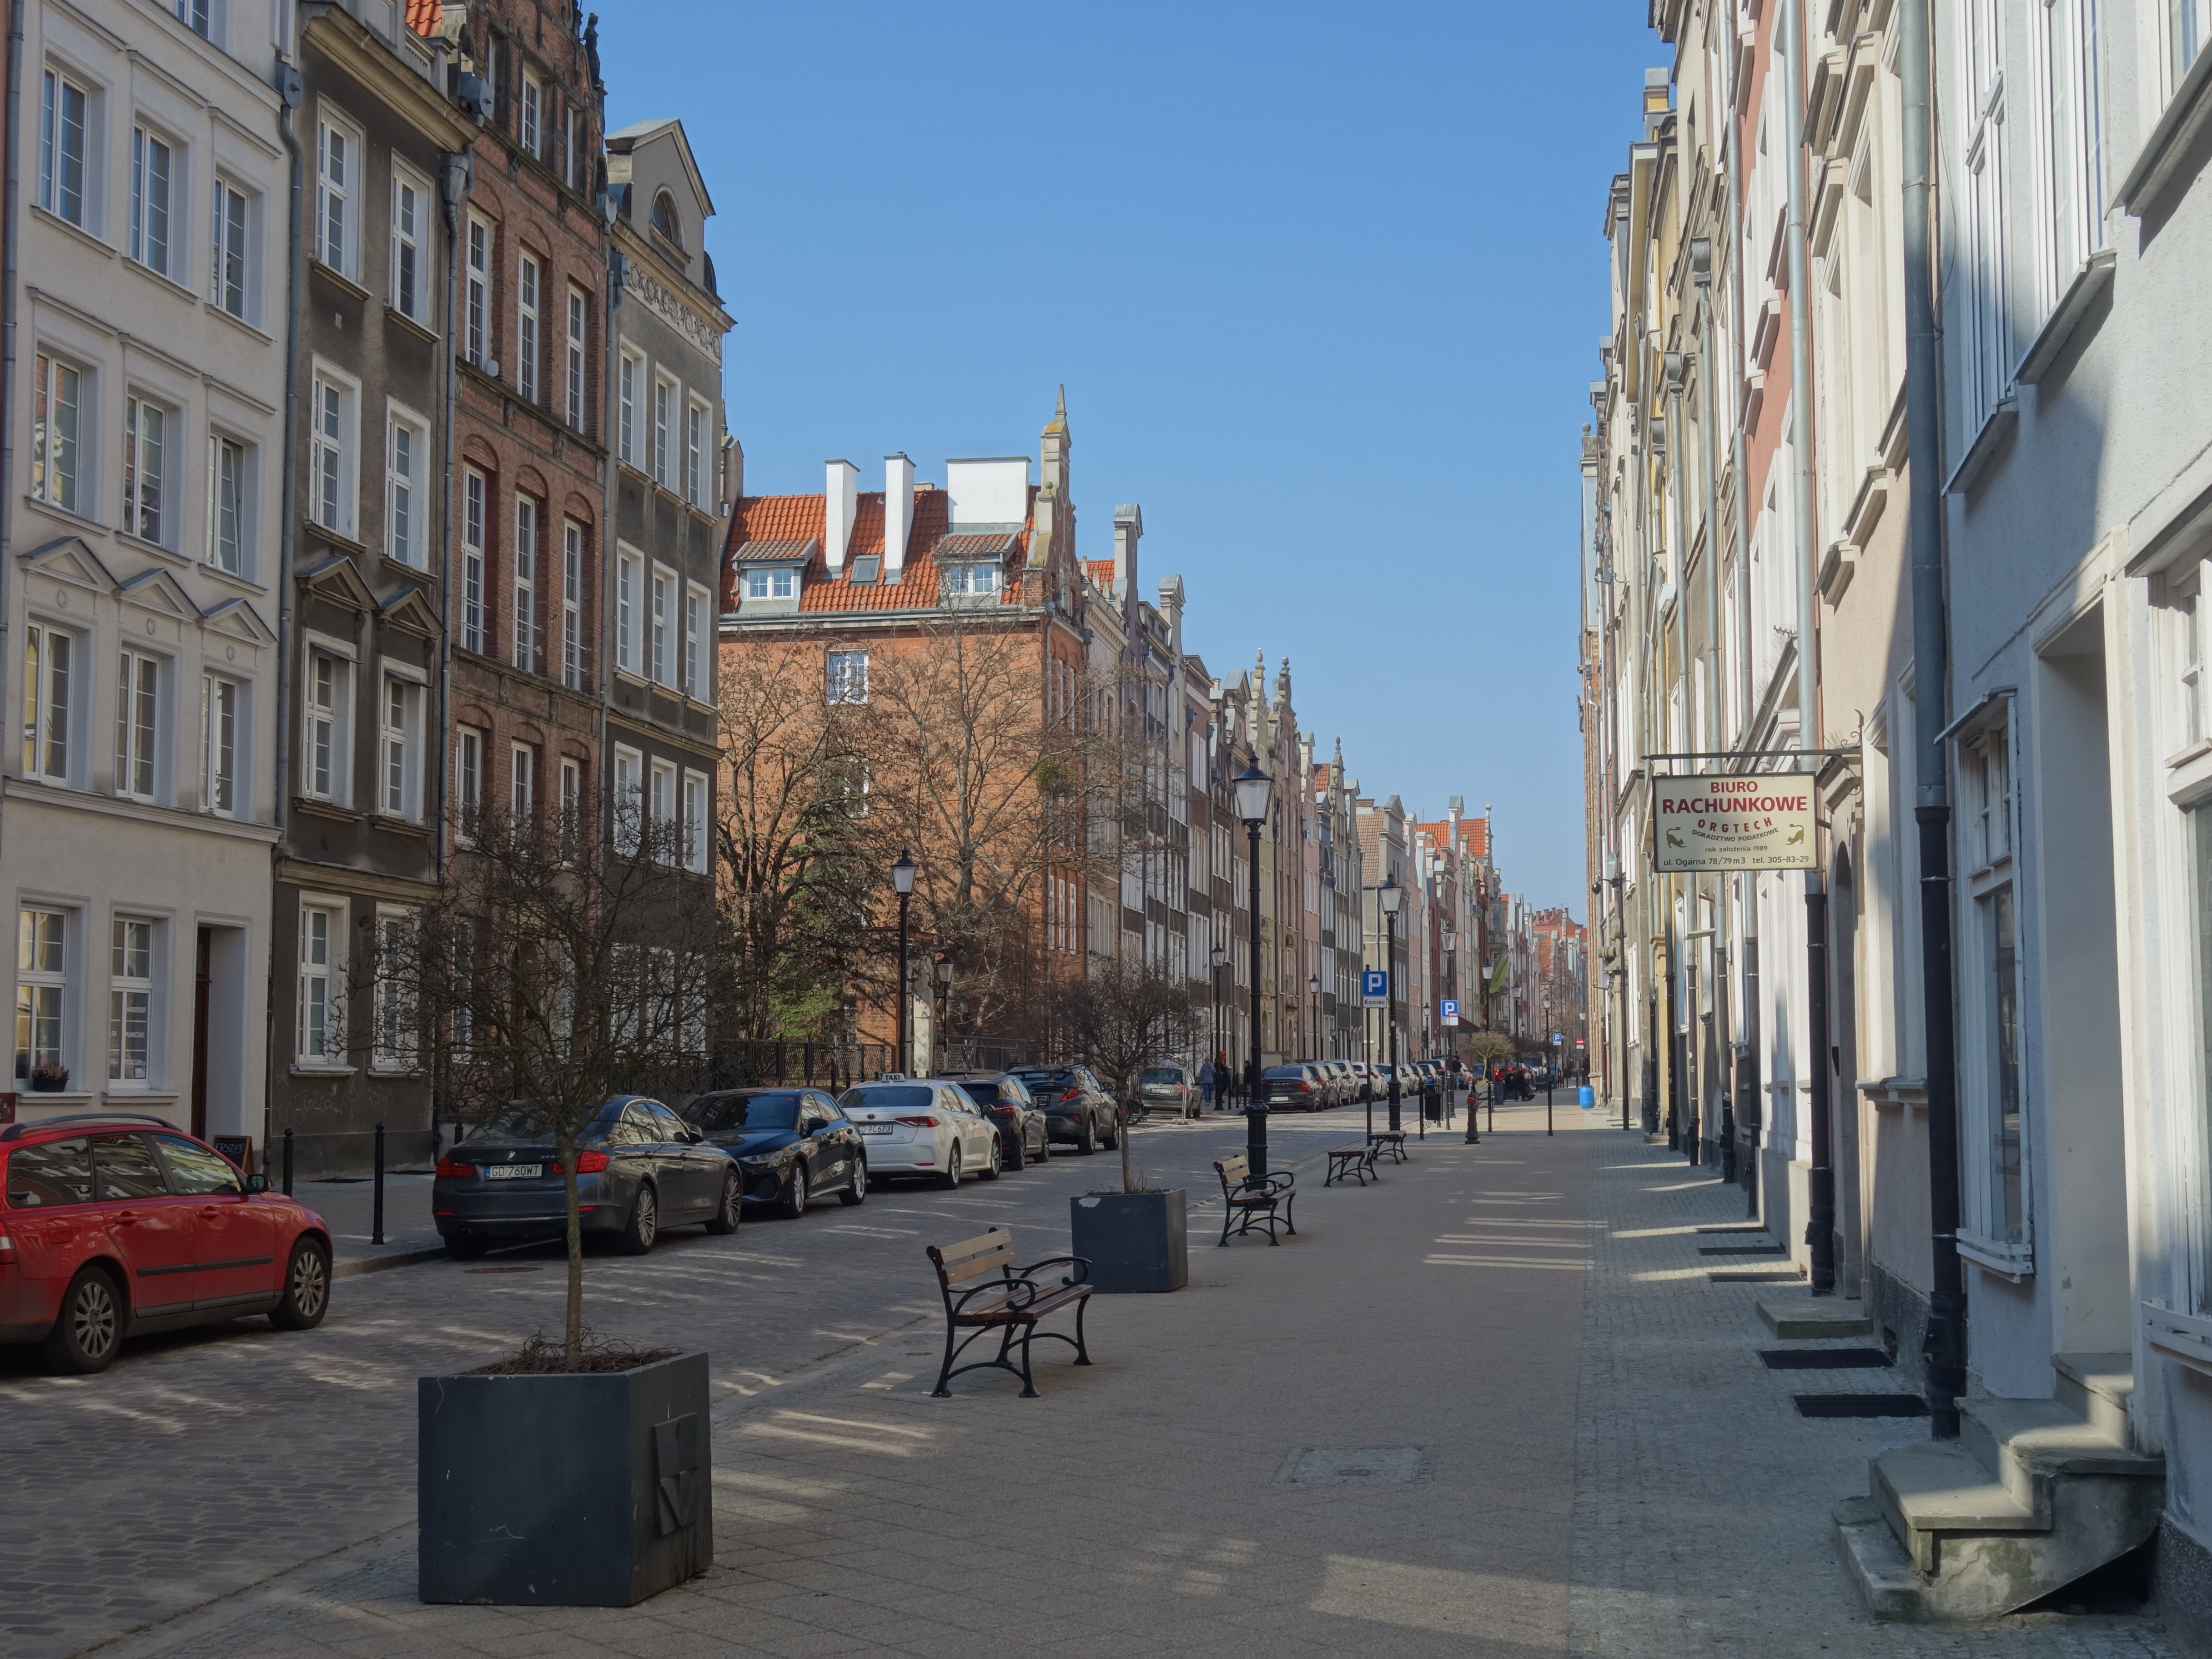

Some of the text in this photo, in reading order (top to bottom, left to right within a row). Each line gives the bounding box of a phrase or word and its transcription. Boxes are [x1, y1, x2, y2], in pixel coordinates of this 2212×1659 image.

[1710, 781, 1758, 793] BIURO
[1662, 796, 1808, 814] RACHUNKOWE
[1698, 817, 1772, 833] ORGTECH
[1691, 827, 1779, 842] DORADZTWO PODATKOWE
[1675, 859, 1706, 867] Ogarna
[1368, 974, 1382, 992] P
[1445, 1002, 1454, 1015] P
[492, 1166, 539, 1176] GD 760WT
